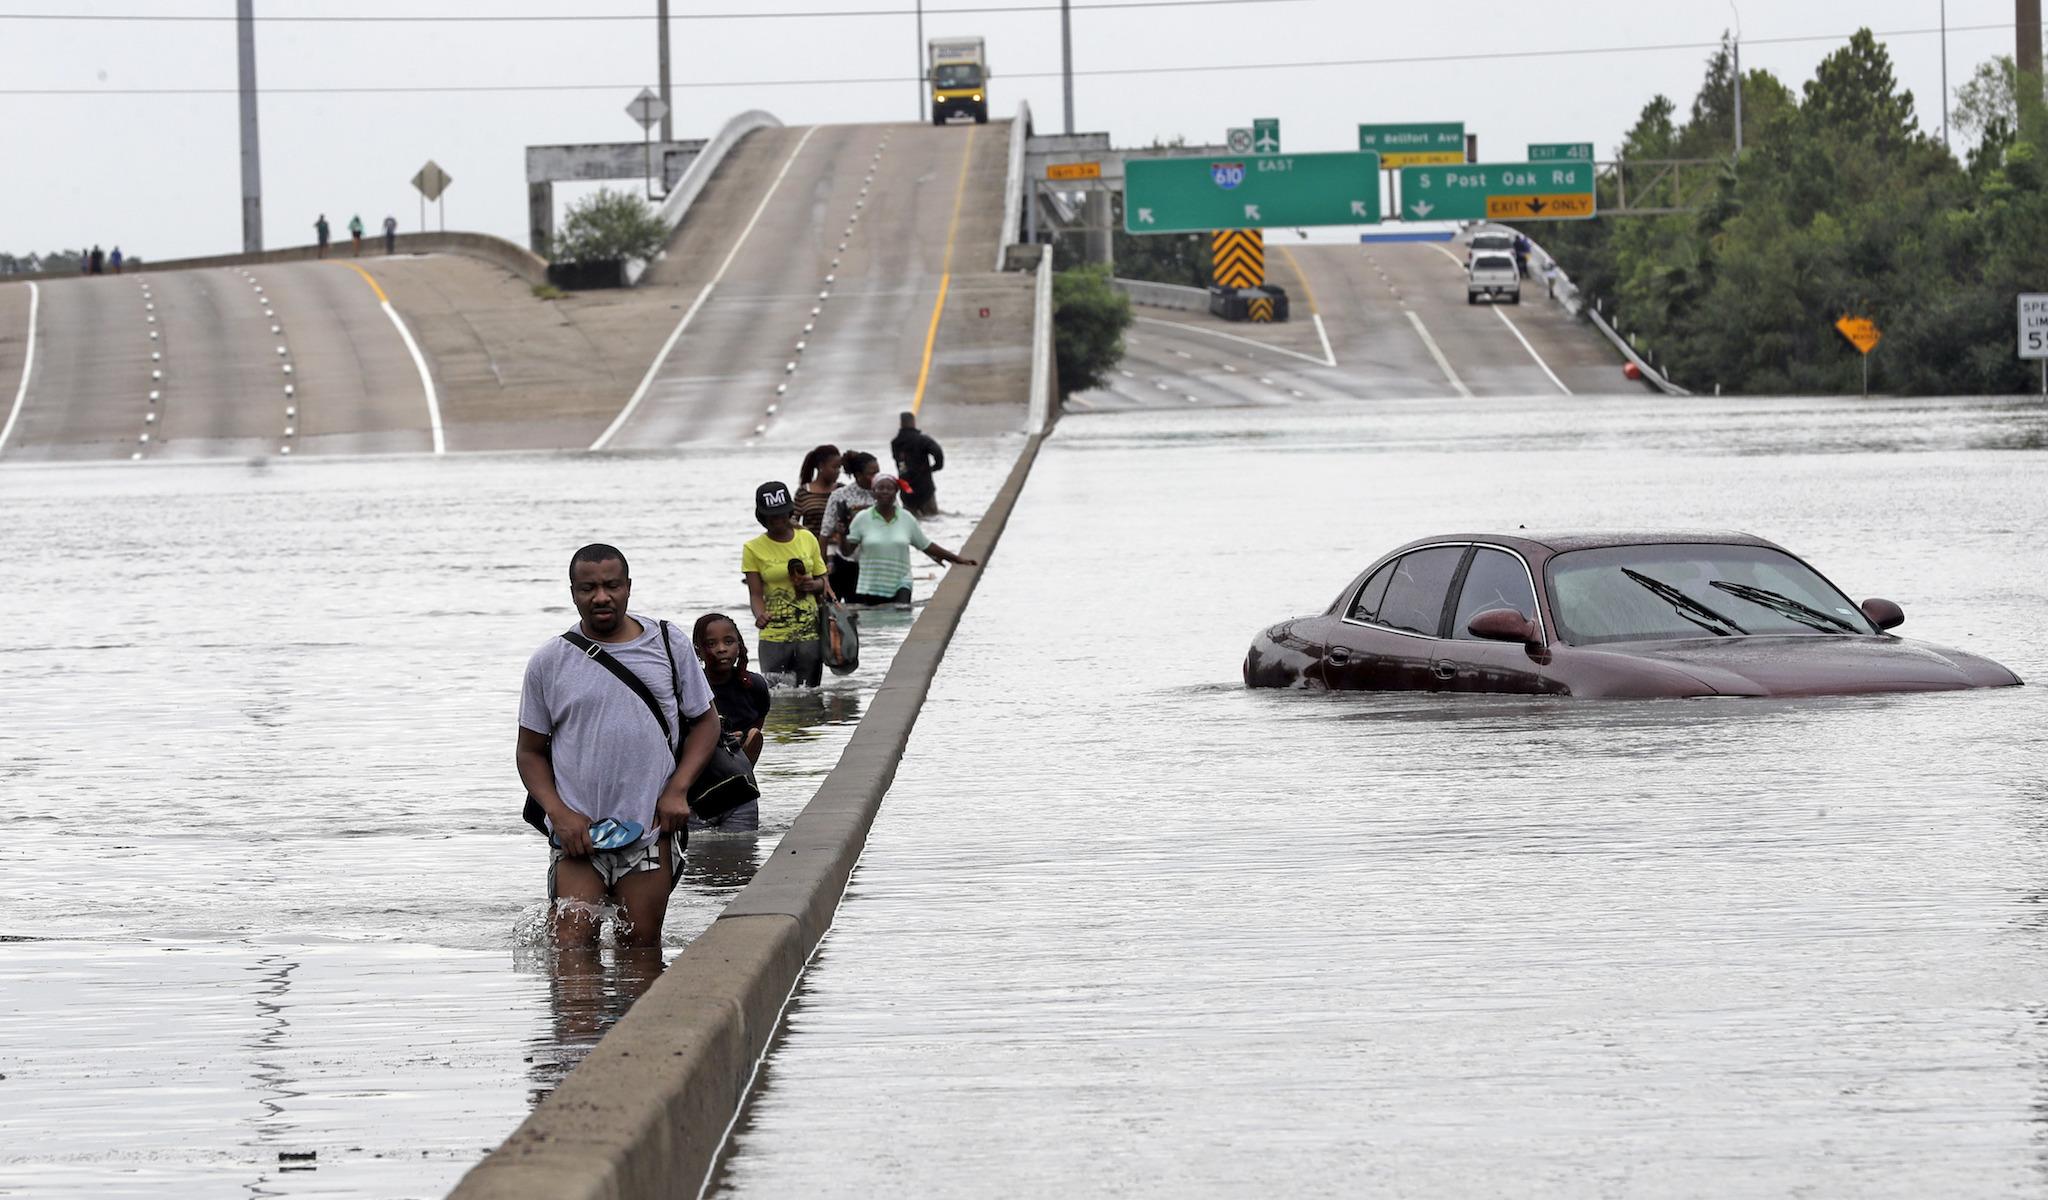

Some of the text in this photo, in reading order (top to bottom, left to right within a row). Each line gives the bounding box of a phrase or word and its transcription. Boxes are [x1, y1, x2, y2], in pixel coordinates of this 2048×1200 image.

[1365, 132, 1459, 144] W Bellfort Ave
[1532, 145, 1589, 158] EXIT 4B
[1257, 159, 1294, 171] EAST
[1215, 168, 1242, 184] 610
[1420, 169, 1575, 188] S Post Oak Rd
[1491, 198, 1588, 212] EXIT ONLY
[2023, 301, 2048, 312] SPE
[2028, 332, 2048, 350] 5
[763, 489, 786, 507] TMT
